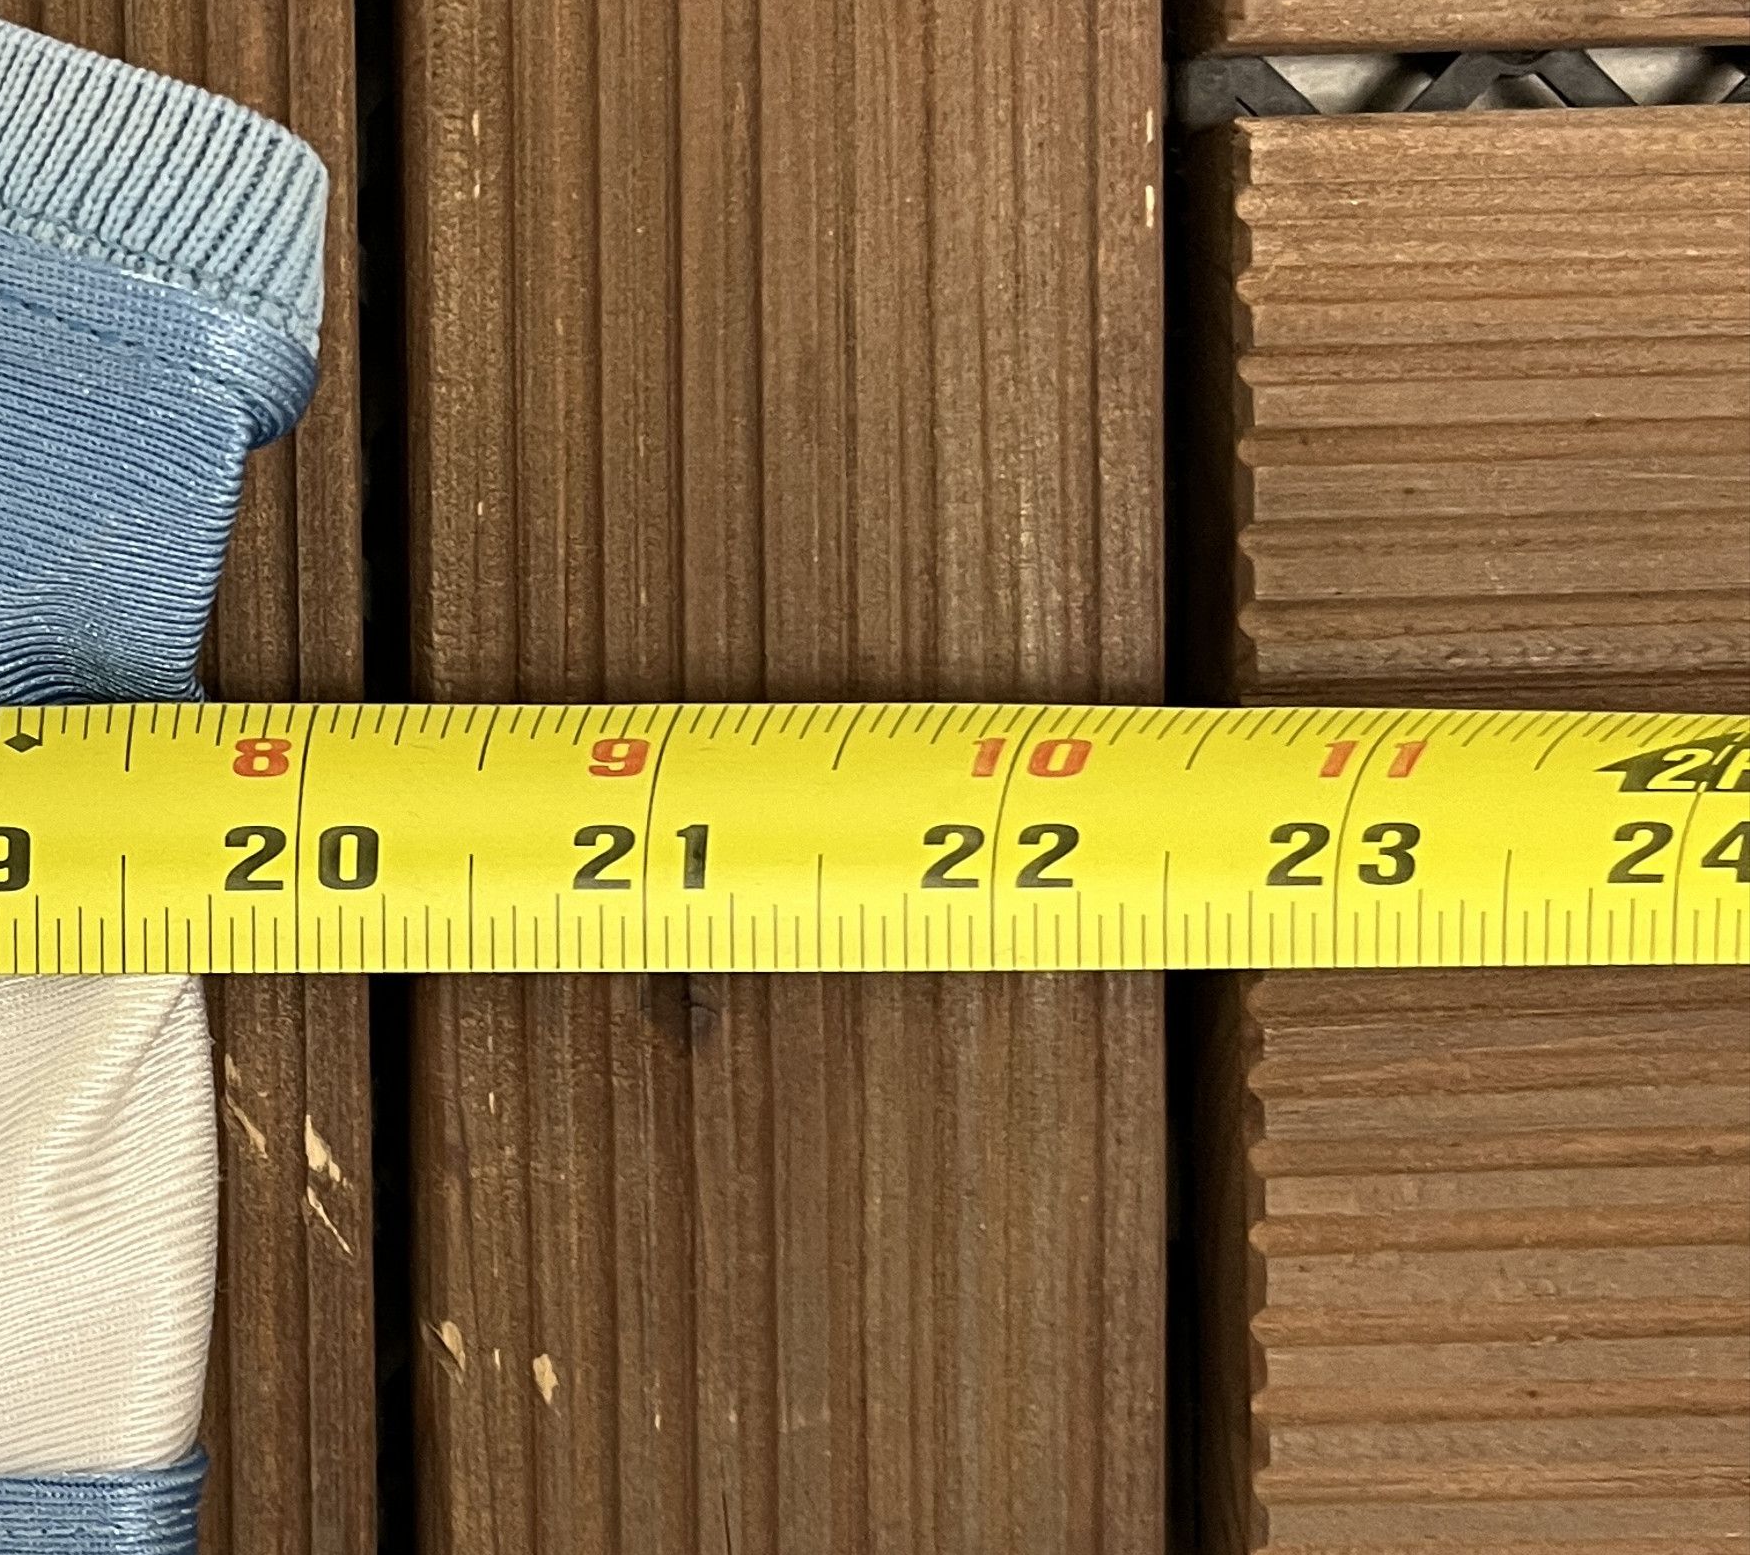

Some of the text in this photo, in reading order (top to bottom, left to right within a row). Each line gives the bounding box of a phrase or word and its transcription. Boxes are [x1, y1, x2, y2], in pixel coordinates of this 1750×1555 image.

[232, 738, 291, 777] 8
[588, 738, 651, 777] 9
[971, 737, 1092, 777] 10
[1319, 739, 1427, 777] 11
[224, 826, 379, 891] 20
[573, 824, 710, 890] 21
[921, 824, 1080, 889] 22
[1266, 823, 1421, 886] 23
[1607, 822, 1750, 884] 24
